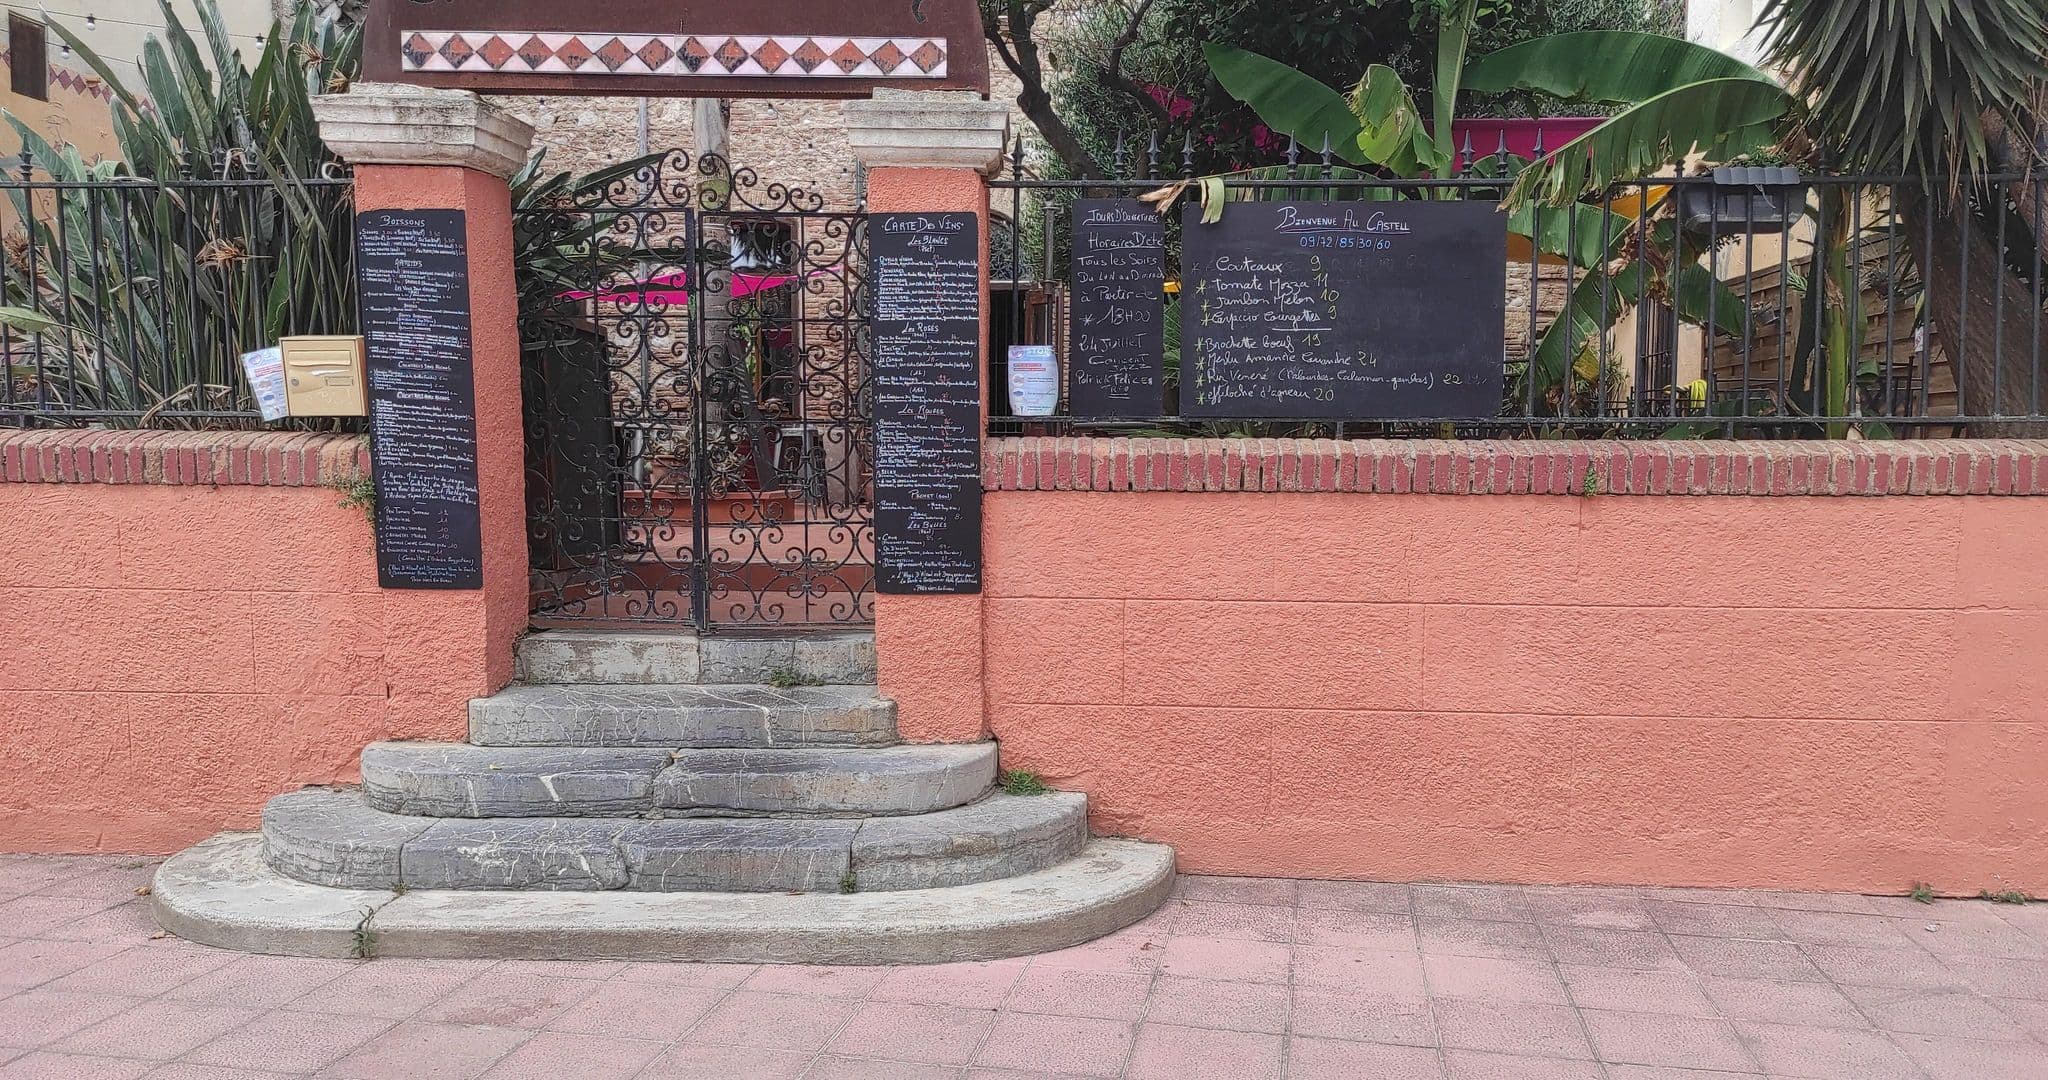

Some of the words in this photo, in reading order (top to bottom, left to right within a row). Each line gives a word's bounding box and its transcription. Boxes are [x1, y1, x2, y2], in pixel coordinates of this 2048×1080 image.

[1275, 207, 1337, 230] BIENVENUE
[1366, 212, 1410, 231] CASTELL
[1110, 253, 1126, 266] les
[1128, 252, 1157, 265] Soirs
[1310, 255, 1321, 272] 9
[1313, 273, 1328, 288] 11
[1320, 289, 1340, 302] 10
[1327, 305, 1337, 320] 9
[1302, 333, 1321, 347] 19
[1358, 350, 1377, 367] 24
[1313, 387, 1335, 402] 20
